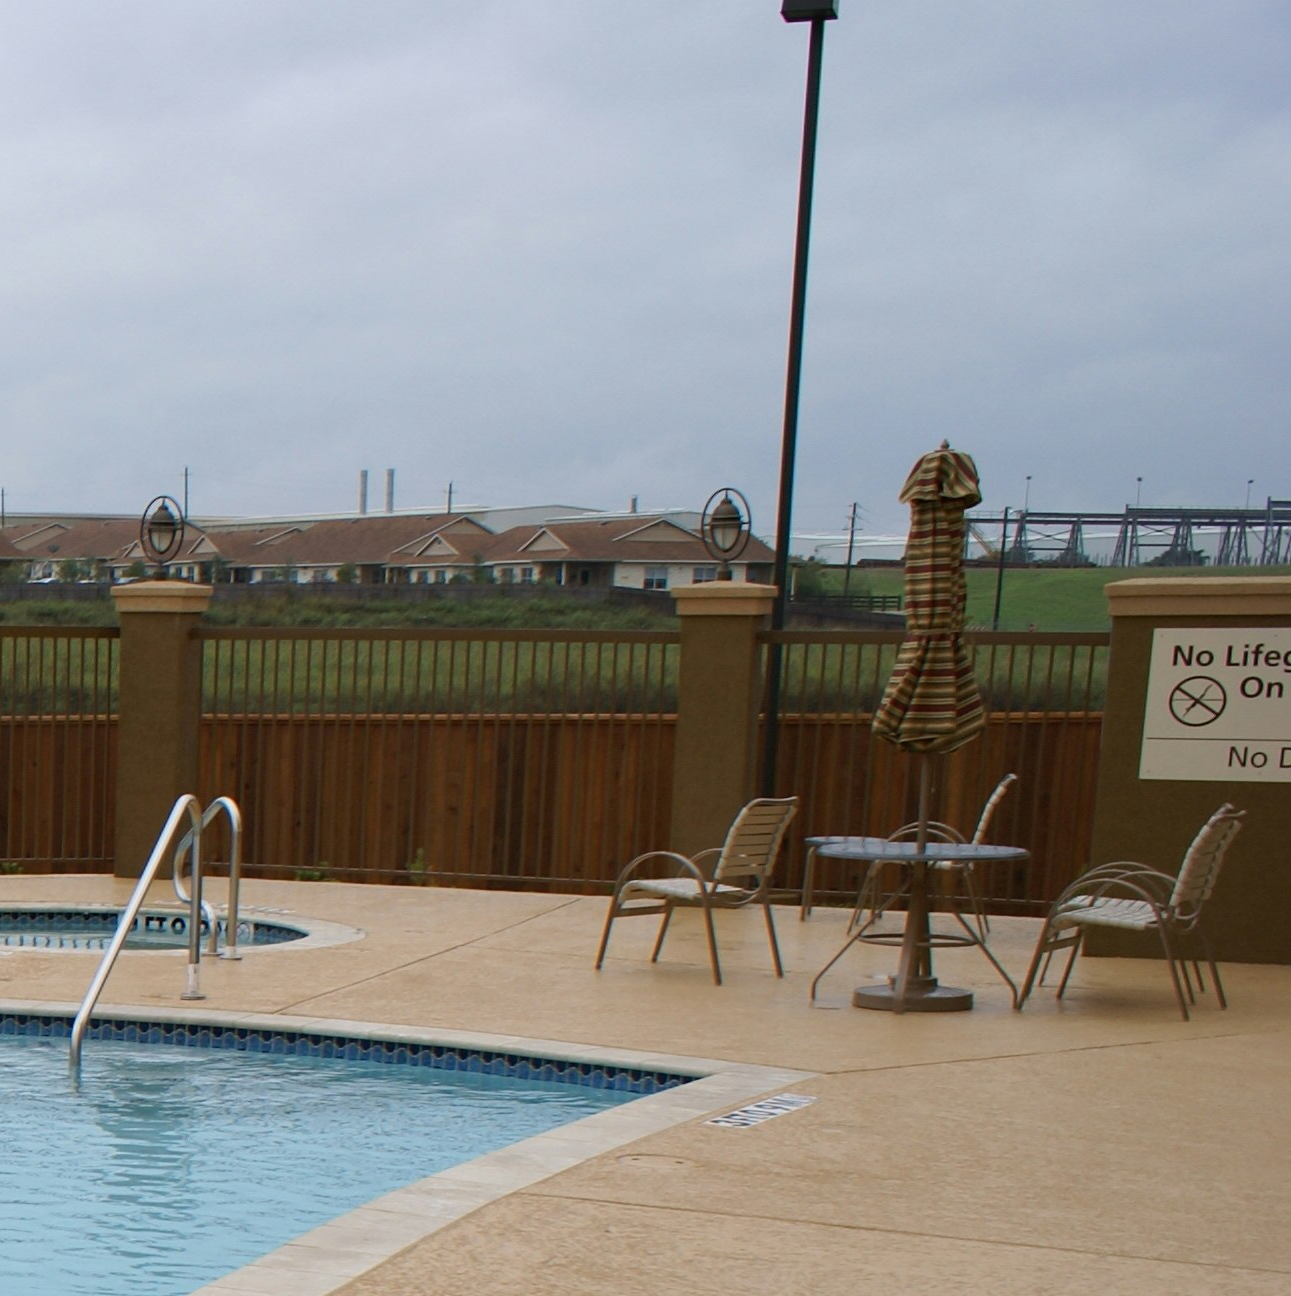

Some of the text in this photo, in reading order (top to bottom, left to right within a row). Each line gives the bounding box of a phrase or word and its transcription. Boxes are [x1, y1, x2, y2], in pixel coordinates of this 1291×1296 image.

[1172, 644, 1214, 667] No
[1240, 676, 1284, 698] On
[1228, 746, 1268, 768] No
